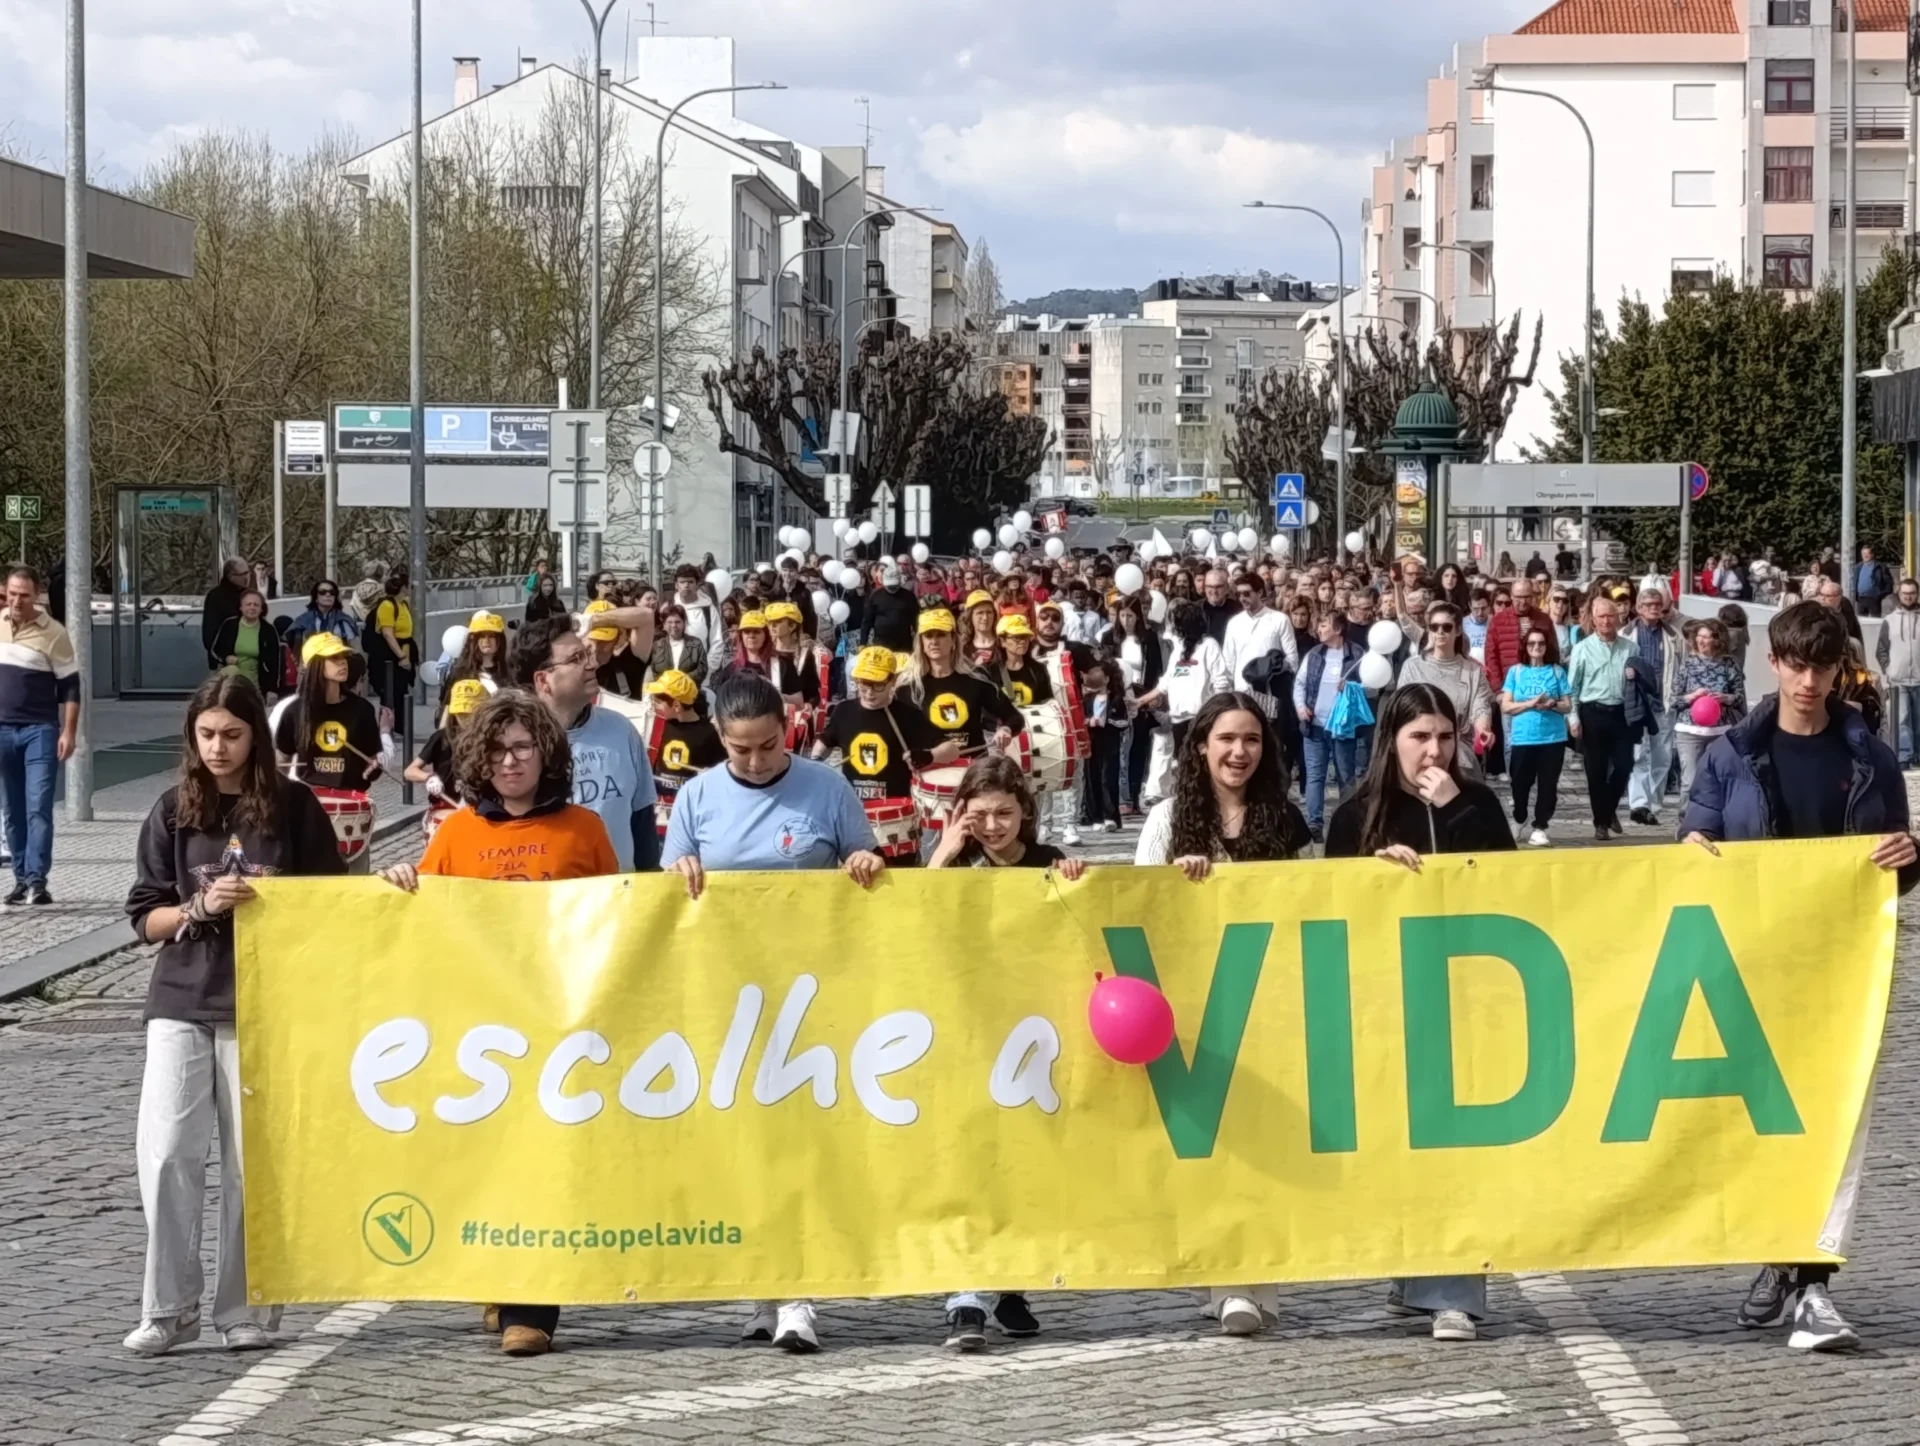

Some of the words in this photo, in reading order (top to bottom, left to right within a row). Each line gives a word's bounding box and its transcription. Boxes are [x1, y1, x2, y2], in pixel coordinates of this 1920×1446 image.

[441, 414, 461, 438] P
[1519, 686, 1544, 696] VID
[478, 843, 549, 862] SEMPRE
[350, 973, 934, 1133] escolhe
[989, 1015, 1061, 1114] a
[1101, 904, 1807, 1160] VIDA
[460, 1220, 742, 1254] #federaçãopelavida
